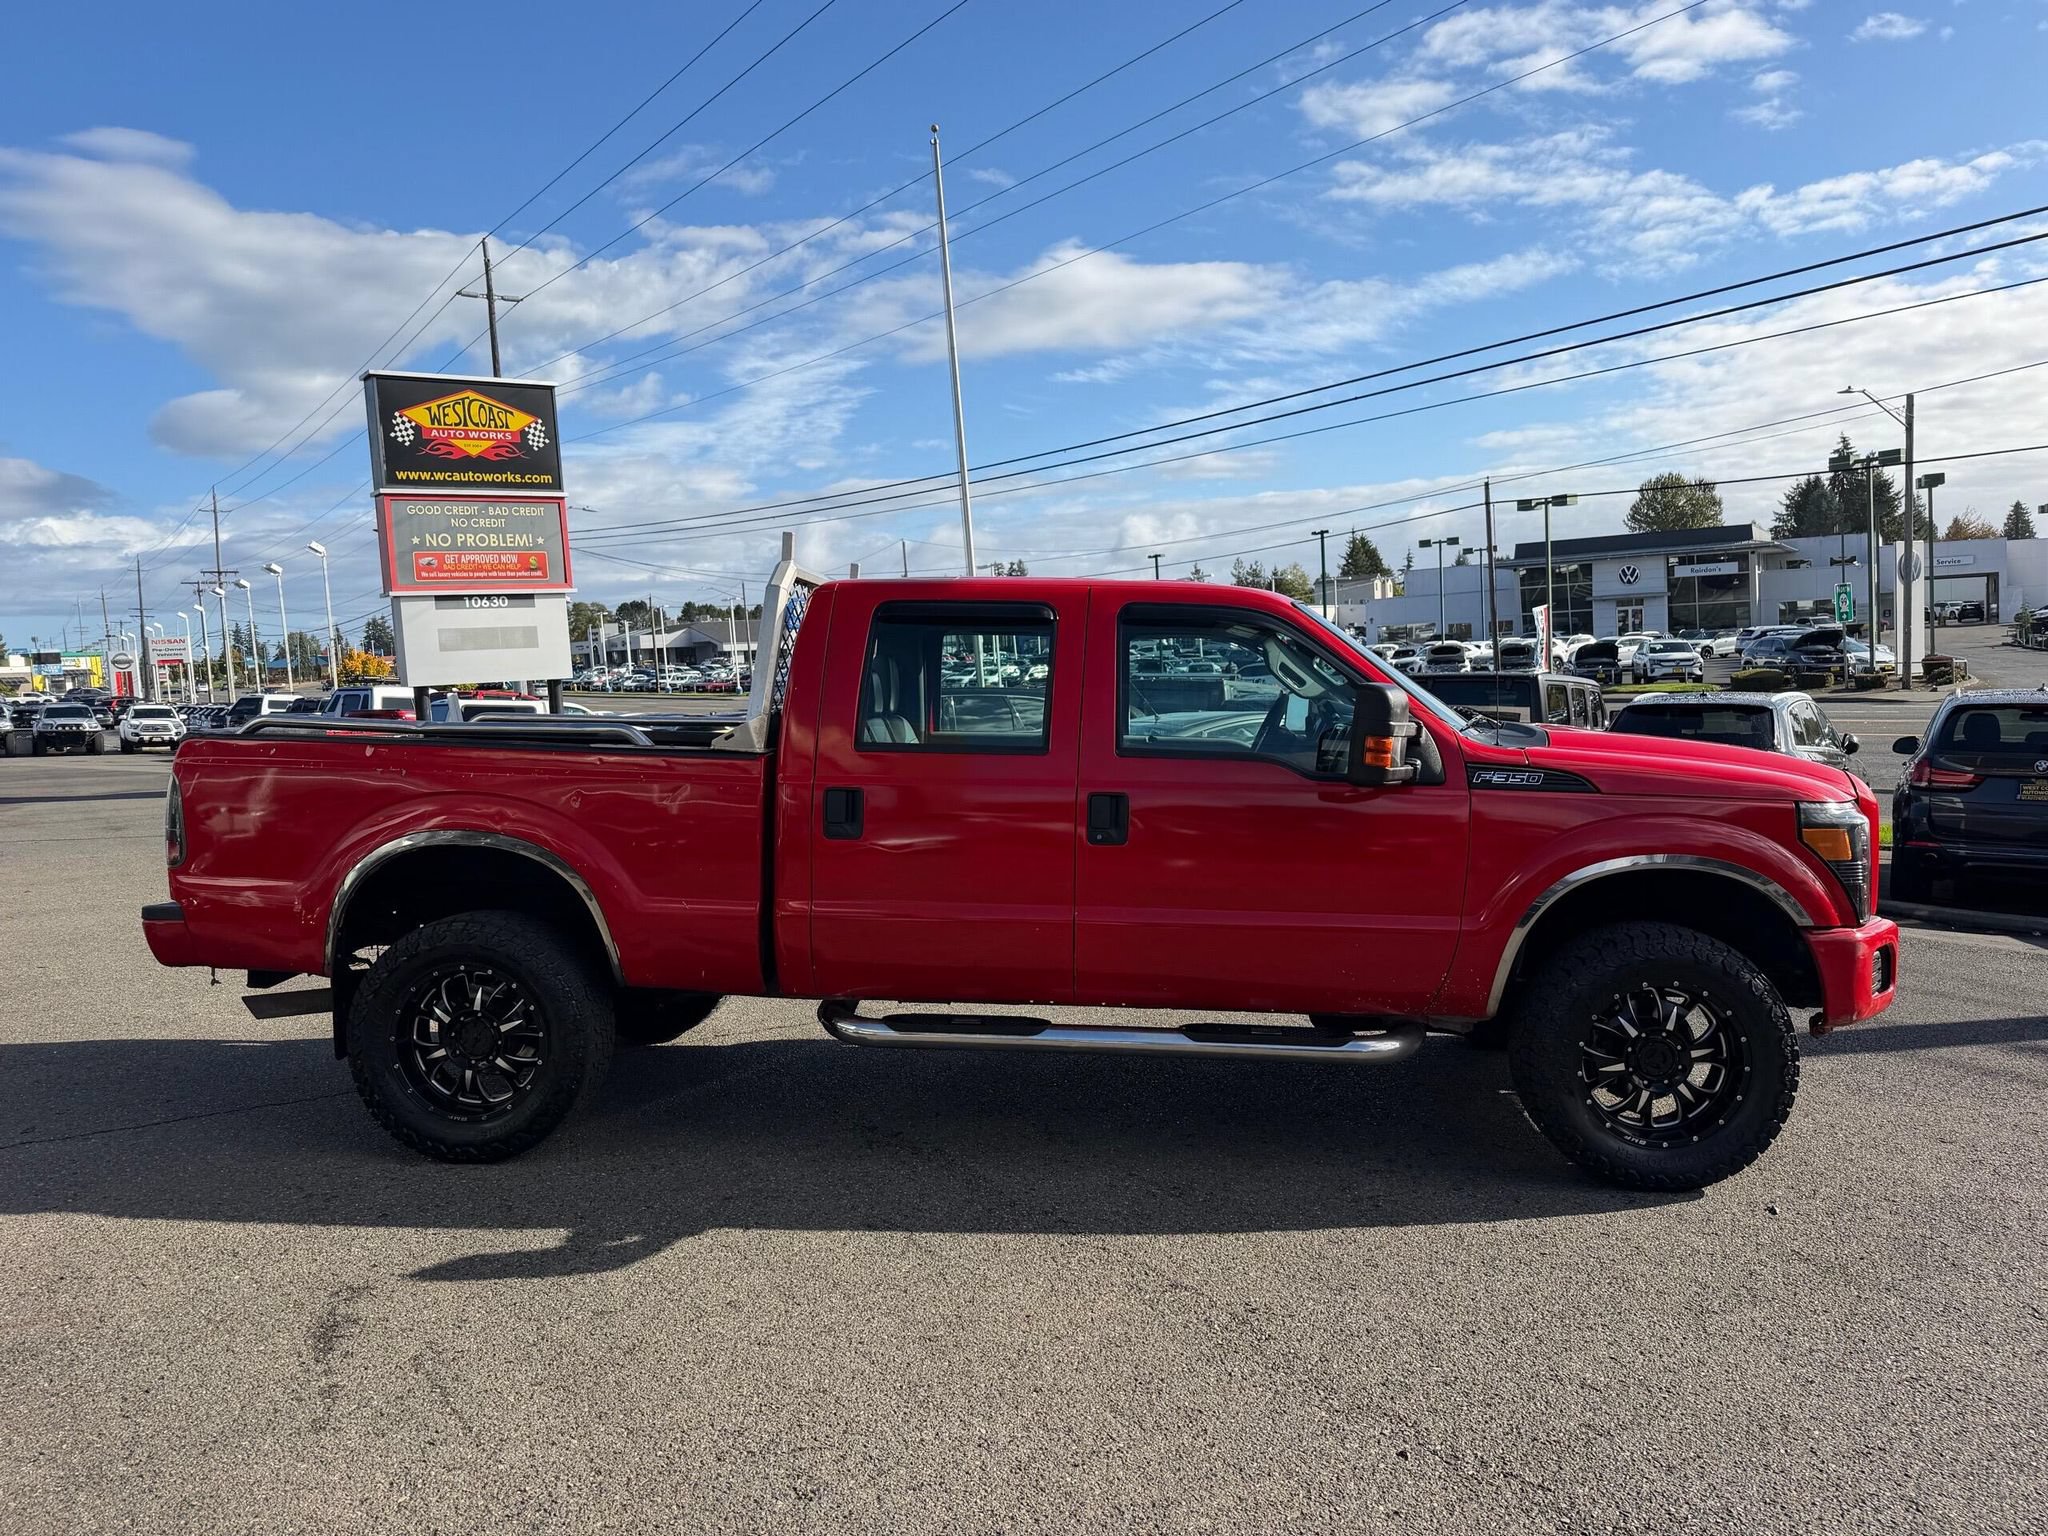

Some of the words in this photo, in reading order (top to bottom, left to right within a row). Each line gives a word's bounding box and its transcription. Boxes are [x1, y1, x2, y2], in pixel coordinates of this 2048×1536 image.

[431, 429, 465, 438] AUTO
[468, 431, 512, 440] WORKS
[395, 470, 552, 484] www.wcautoworks.com
[406, 505, 441, 515] GOOD
[444, 506, 478, 516] CREDIT
[488, 506, 509, 516] BAD
[512, 507, 545, 516] CREDIT
[450, 518, 468, 528] NO
[470, 518, 506, 528] CREDIT
[425, 533, 452, 547] NO
[457, 533, 534, 547] PROBLEM!
[444, 554, 459, 564] GET
[460, 554, 499, 564] APPROVED
[500, 554, 518, 564] NOW
[464, 596, 508, 608] 10630
